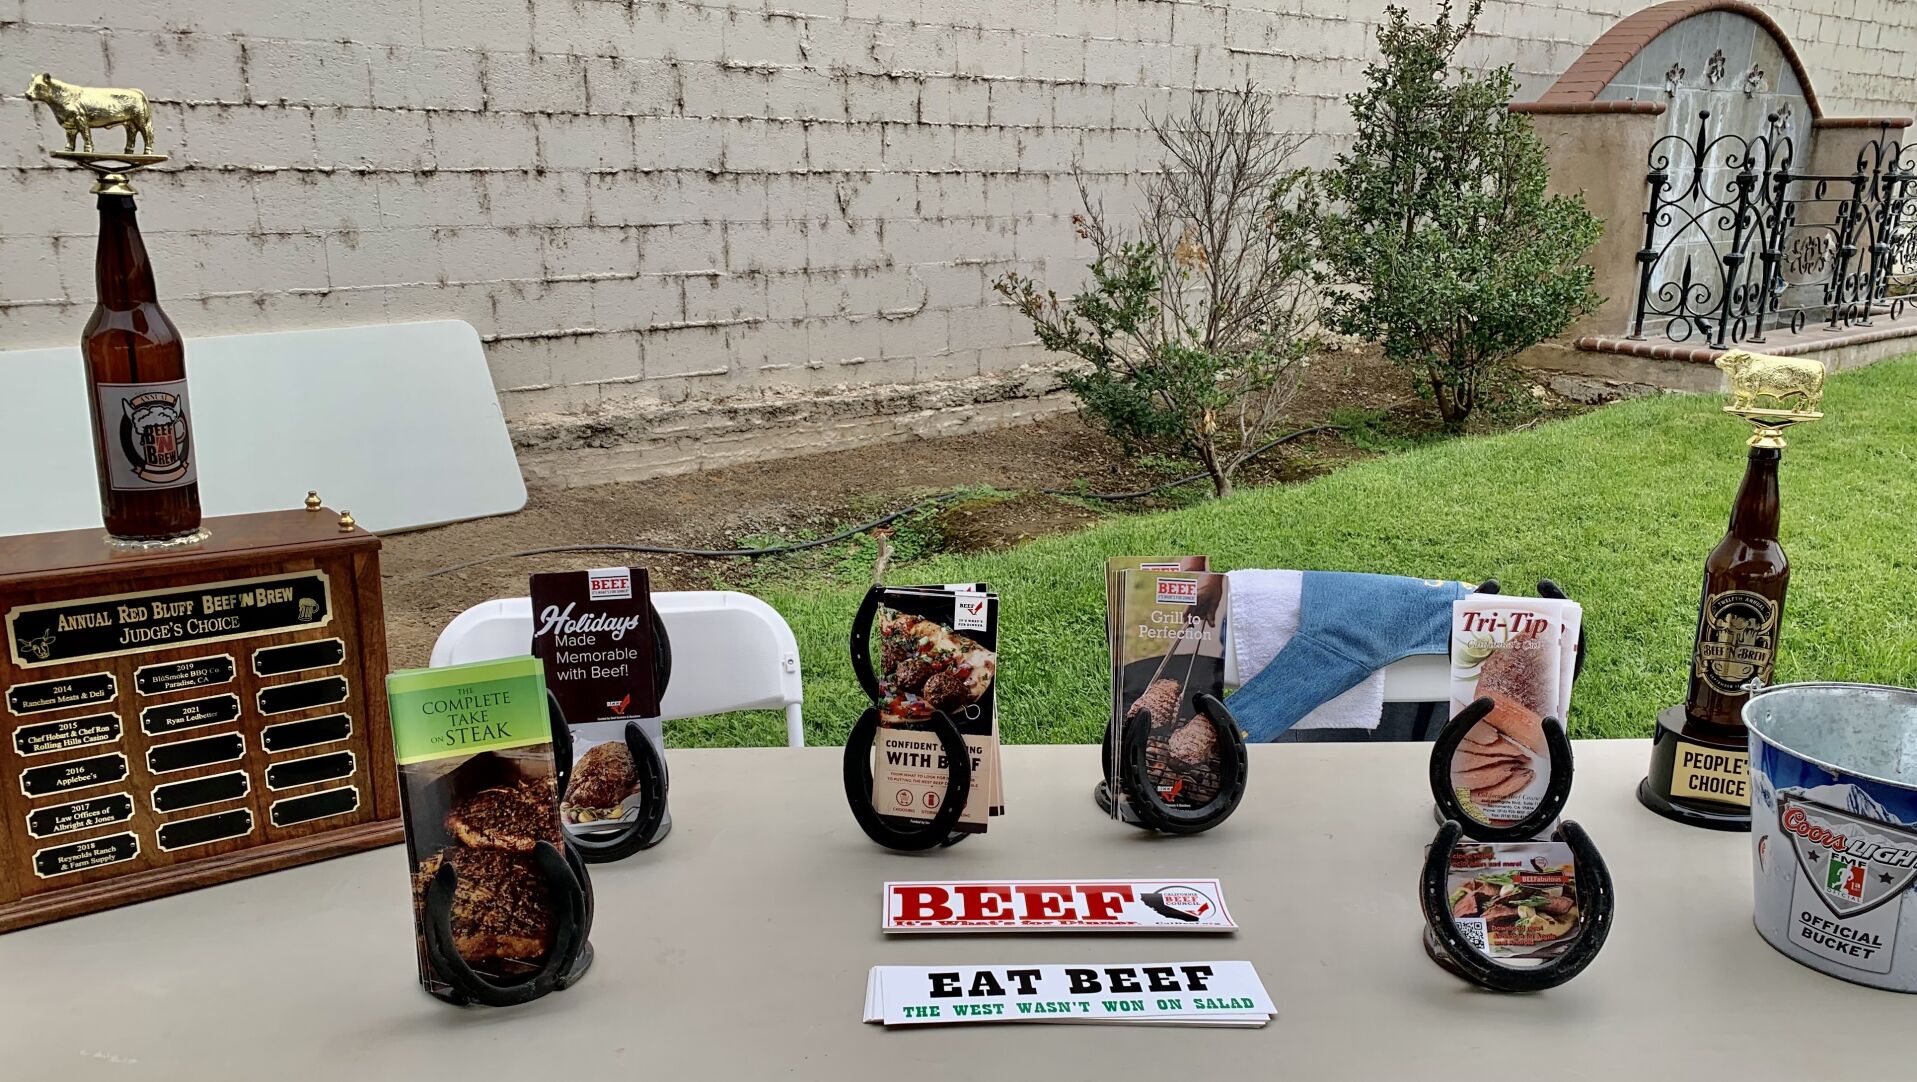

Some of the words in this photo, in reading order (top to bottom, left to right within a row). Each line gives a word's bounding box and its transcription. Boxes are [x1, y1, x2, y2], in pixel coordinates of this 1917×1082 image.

[143, 424, 174, 445] BEEF
[146, 445, 177, 465] BREW
[57, 611, 112, 632] ANNUAL
[118, 605, 148, 624] RED
[152, 601, 194, 620] BLUFF
[202, 594, 237, 614] BEEF
[255, 587, 293, 607] BREW
[1151, 610, 1184, 624] Grill
[1187, 613, 1201, 625] to
[534, 602, 640, 641] Holidays
[1462, 612, 1548, 639] Tri-Tip
[119, 622, 183, 644] JUDGE'S
[187, 616, 241, 635] CHOICE
[1138, 624, 1212, 640] Perfection
[555, 634, 596, 647] Made
[556, 648, 638, 664] Memorable
[1703, 645, 1725, 657] BEEF
[1737, 648, 1766, 661] BREW
[176, 663, 194, 672] 2019
[190, 669, 208, 678] BBQ
[557, 668, 587, 680] with
[591, 664, 629, 679] Beef!
[53, 685, 72, 694] 2014
[457, 687, 473, 695] THE
[22, 698, 56, 708] Ranchers
[57, 694, 79, 703] Meats
[89, 690, 105, 698] Deli
[422, 691, 511, 715] COMPLETE
[166, 716, 185, 726] Ryan
[186, 711, 218, 722] Ledbetter
[182, 706, 200, 715] 2021
[447, 710, 489, 727] TAKE
[28, 735, 46, 744] Chef
[46, 732, 70, 742] Hobart
[70, 730, 78, 738] &
[78, 727, 95, 736] Chef
[95, 725, 110, 733] Ron
[59, 722, 78, 731] 2015
[430, 736, 444, 744] ON
[445, 721, 512, 746] STEAK
[33, 741, 63, 751] Rolling
[63, 738, 82, 747] Hills
[83, 734, 109, 743] Casino
[886, 739, 938, 751] CONFIDENT
[886, 751, 931, 768] WITH
[938, 755, 982, 772] BF
[56, 772, 97, 786] Applebee's
[65, 767, 85, 776] 2016
[1688, 774, 1747, 797] CHOICE
[71, 803, 90, 813] 2017
[53, 820, 84, 833] Albright
[85, 818, 93, 826] &
[94, 815, 115, 824] Jones
[55, 816, 72, 824] Law
[73, 810, 101, 820] Offices
[1782, 805, 1848, 852] Coors
[1846, 840, 1917, 870] LIGH
[57, 851, 92, 864] Reynolds
[93, 846, 117, 856] Ranch
[76, 843, 96, 852] 2018
[69, 860, 90, 869] Farm
[90, 854, 116, 864] Supply
[1831, 852, 1868, 867] FMF
[1522, 875, 1562, 883] BEEFabulous
[893, 885, 1135, 921] BEEF
[1801, 911, 1883, 946] OFFICIAL
[1801, 927, 1875, 959] BUCKET
[928, 969, 1042, 998] EAT
[1064, 965, 1214, 994] BEEF
[903, 1005, 941, 1018] THE
[953, 1003, 1005, 1016] WEST
[1016, 1001, 1091, 1014] WASN'T
[1102, 1000, 1145, 1012] WON
[1157, 998, 1183, 1011] ON
[1194, 997, 1255, 1010] SALAD
